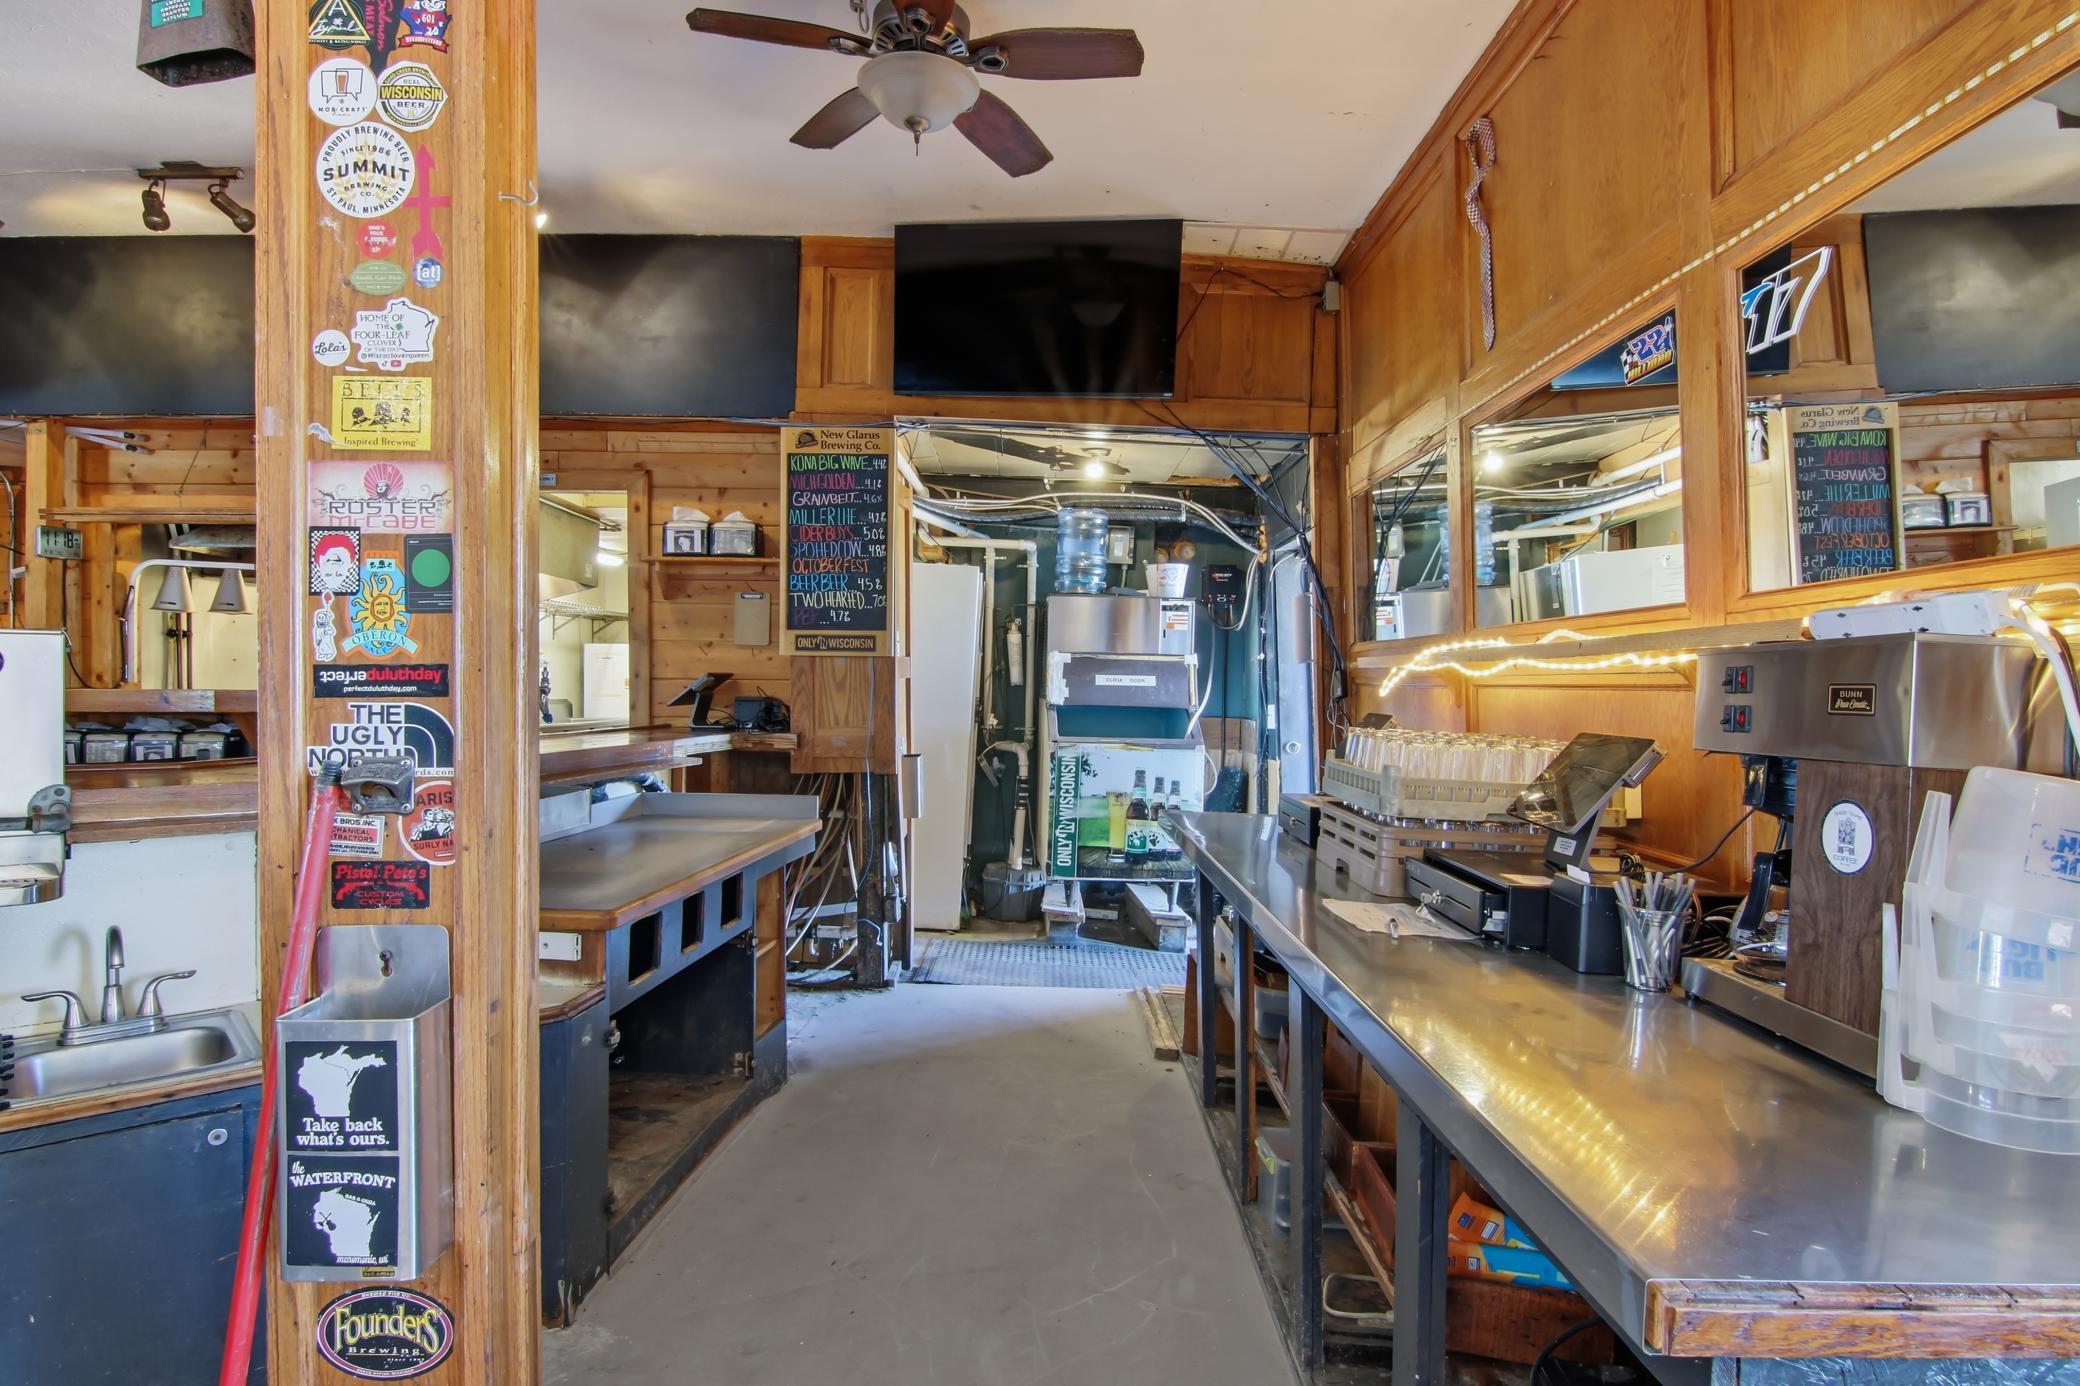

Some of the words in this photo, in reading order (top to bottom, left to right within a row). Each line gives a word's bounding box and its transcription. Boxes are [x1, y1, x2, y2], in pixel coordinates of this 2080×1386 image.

[381, 86, 442, 100] WISCONSIN
[323, 129, 351, 162] PROUDLY
[354, 126, 394, 142] BREWING
[394, 141, 410, 162] BEER
[341, 145, 363, 156] SINCE
[368, 144, 391, 156] 1986
[324, 159, 410, 181] SUMMIT
[344, 182, 388, 191] BREWING
[362, 187, 406, 214] MINNESOTA
[1740, 246, 1832, 355] 17
[360, 314, 389, 322] HOME
[392, 314, 405, 322] OF
[355, 331, 411, 340] FOUR-LEAF
[314, 342, 346, 355] Lola's
[344, 437, 379, 446] Inspired
[381, 437, 416, 447] Brewing
[821, 430, 844, 439] New
[846, 430, 880, 440] Glarus
[821, 440, 862, 452] Brewing
[864, 441, 881, 450] Co.
[791, 455, 817, 471] KONA
[818, 455, 839, 470] BIG
[839, 455, 869, 471] WAVE
[329, 501, 436, 514] ROSTER
[789, 506, 836, 526] MILLER
[790, 573, 819, 591] BEER
[820, 573, 849, 592] BEER
[790, 591, 824, 608] TWO
[352, 630, 408, 646] OBERON
[798, 637, 817, 648] ONLY
[828, 638, 874, 649] WISCONSIN
[344, 685, 417, 693] perfectduluthday.com
[1840, 690, 1863, 698] BUNN
[350, 705, 402, 724] THE
[332, 726, 403, 745] UGLY
[1060, 757, 1076, 820] WISCONSIN
[413, 841, 440, 850] SURLY
[1057, 837, 1072, 866] ONLY
[335, 865, 379, 879] Pistol
[382, 865, 427, 879] Pete's
[303, 1117, 339, 1132] Take
[345, 1117, 383, 1131] back
[297, 1132, 344, 1146] what's
[350, 1134, 390, 1145] ours.
[292, 1160, 305, 1174] the
[290, 1172, 395, 1189] WATERFRONT
[348, 1347, 421, 1356] Brewing
